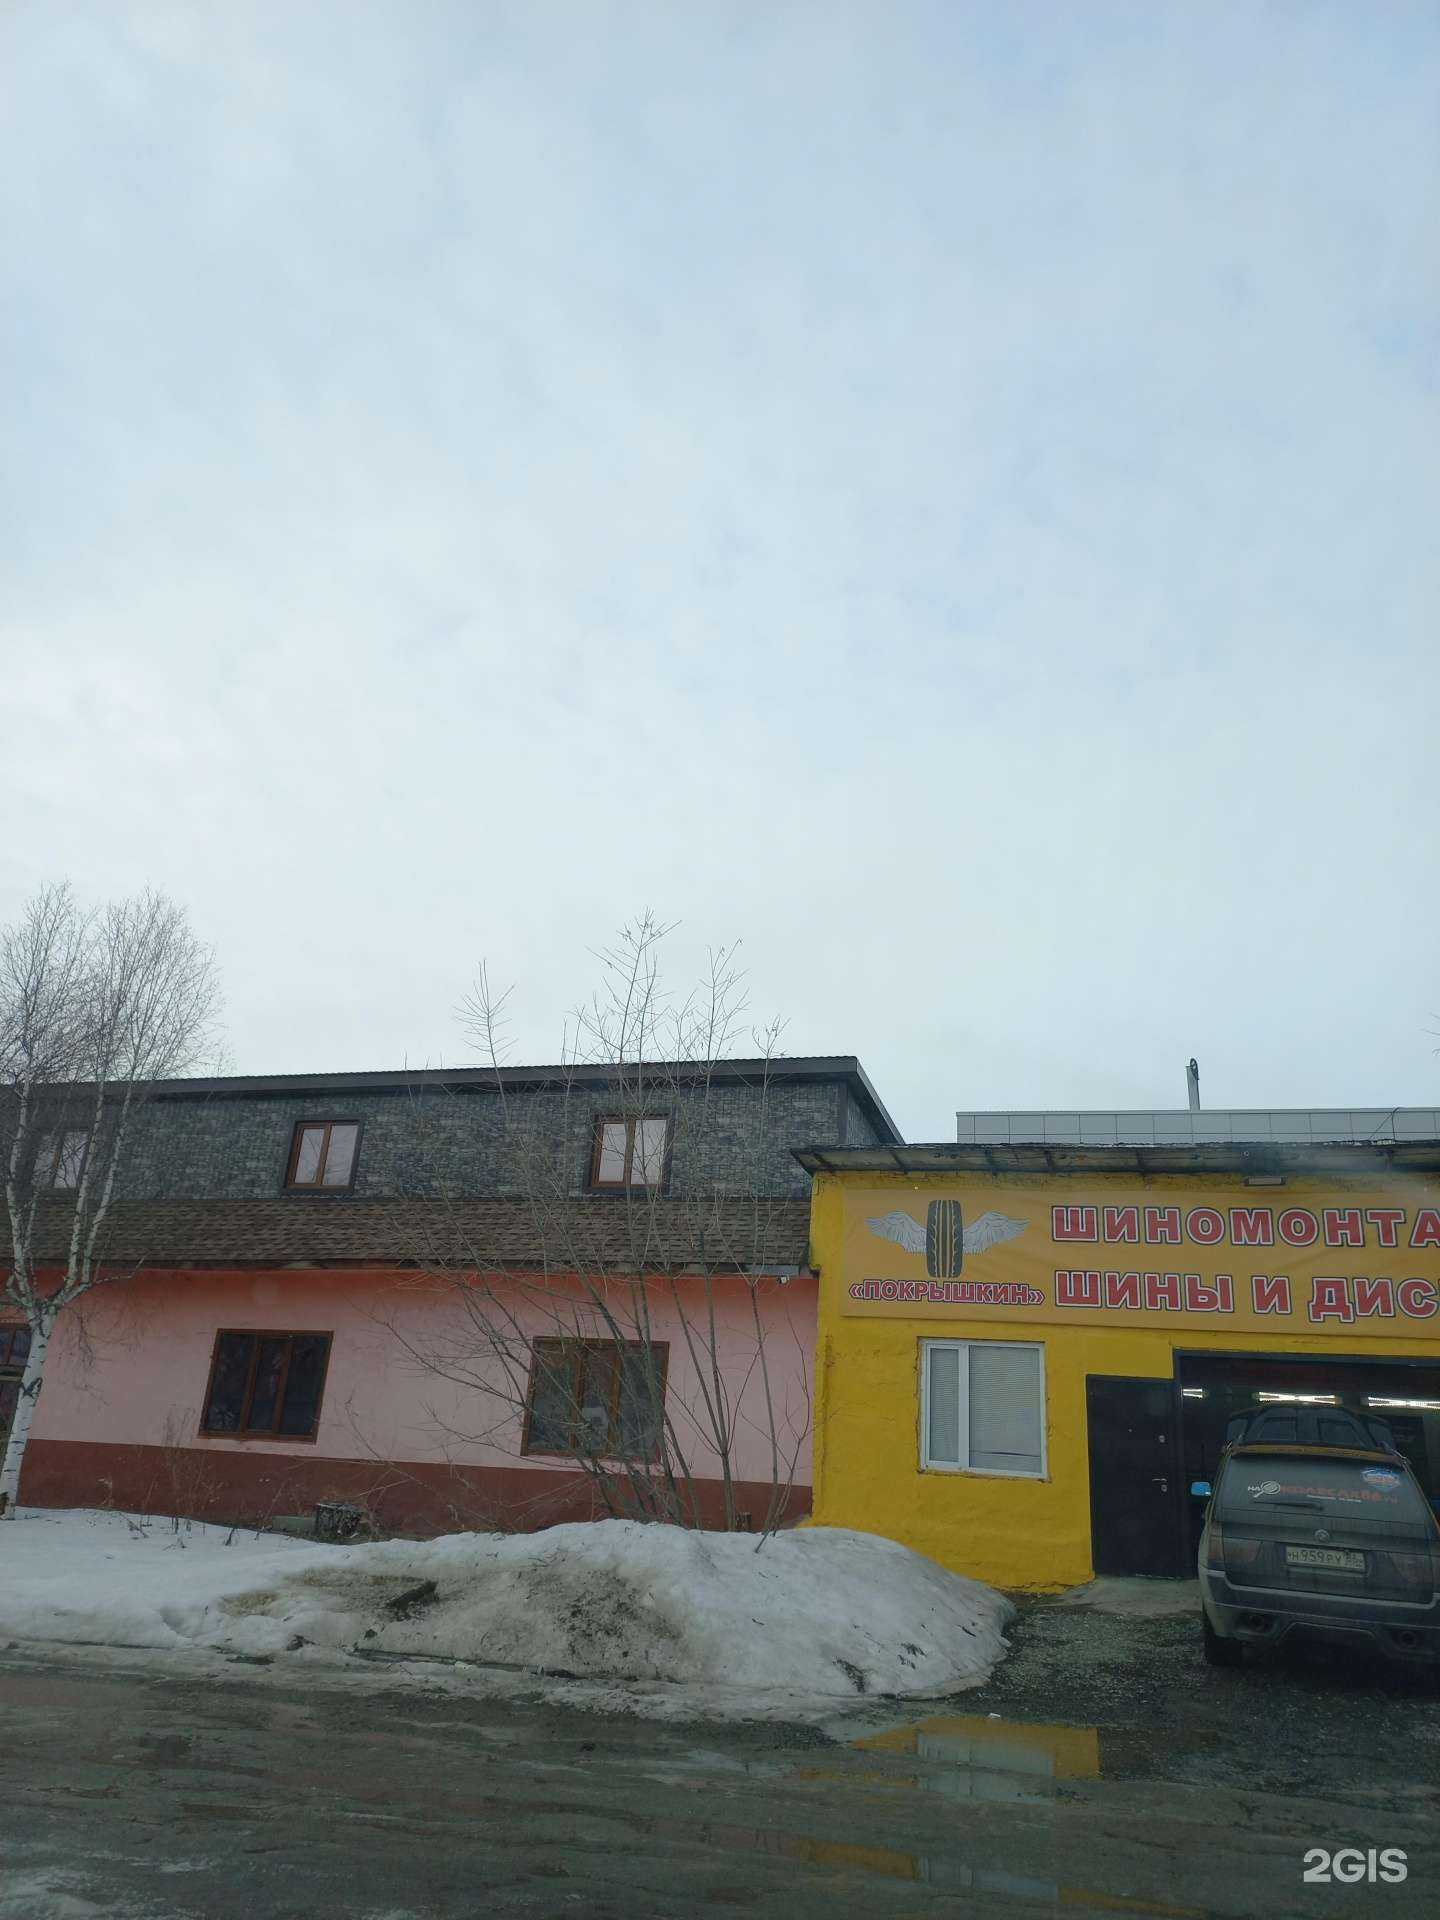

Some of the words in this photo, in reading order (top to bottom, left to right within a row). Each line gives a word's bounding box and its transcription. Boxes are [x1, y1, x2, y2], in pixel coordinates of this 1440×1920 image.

[849, 1279, 1045, 1305] «ПОКРЫШКИН»
[1054, 1269, 1234, 1313] ШИНЫ
[1252, 1275, 1293, 1315] И
[1308, 1276, 1440, 1324] ДИС
